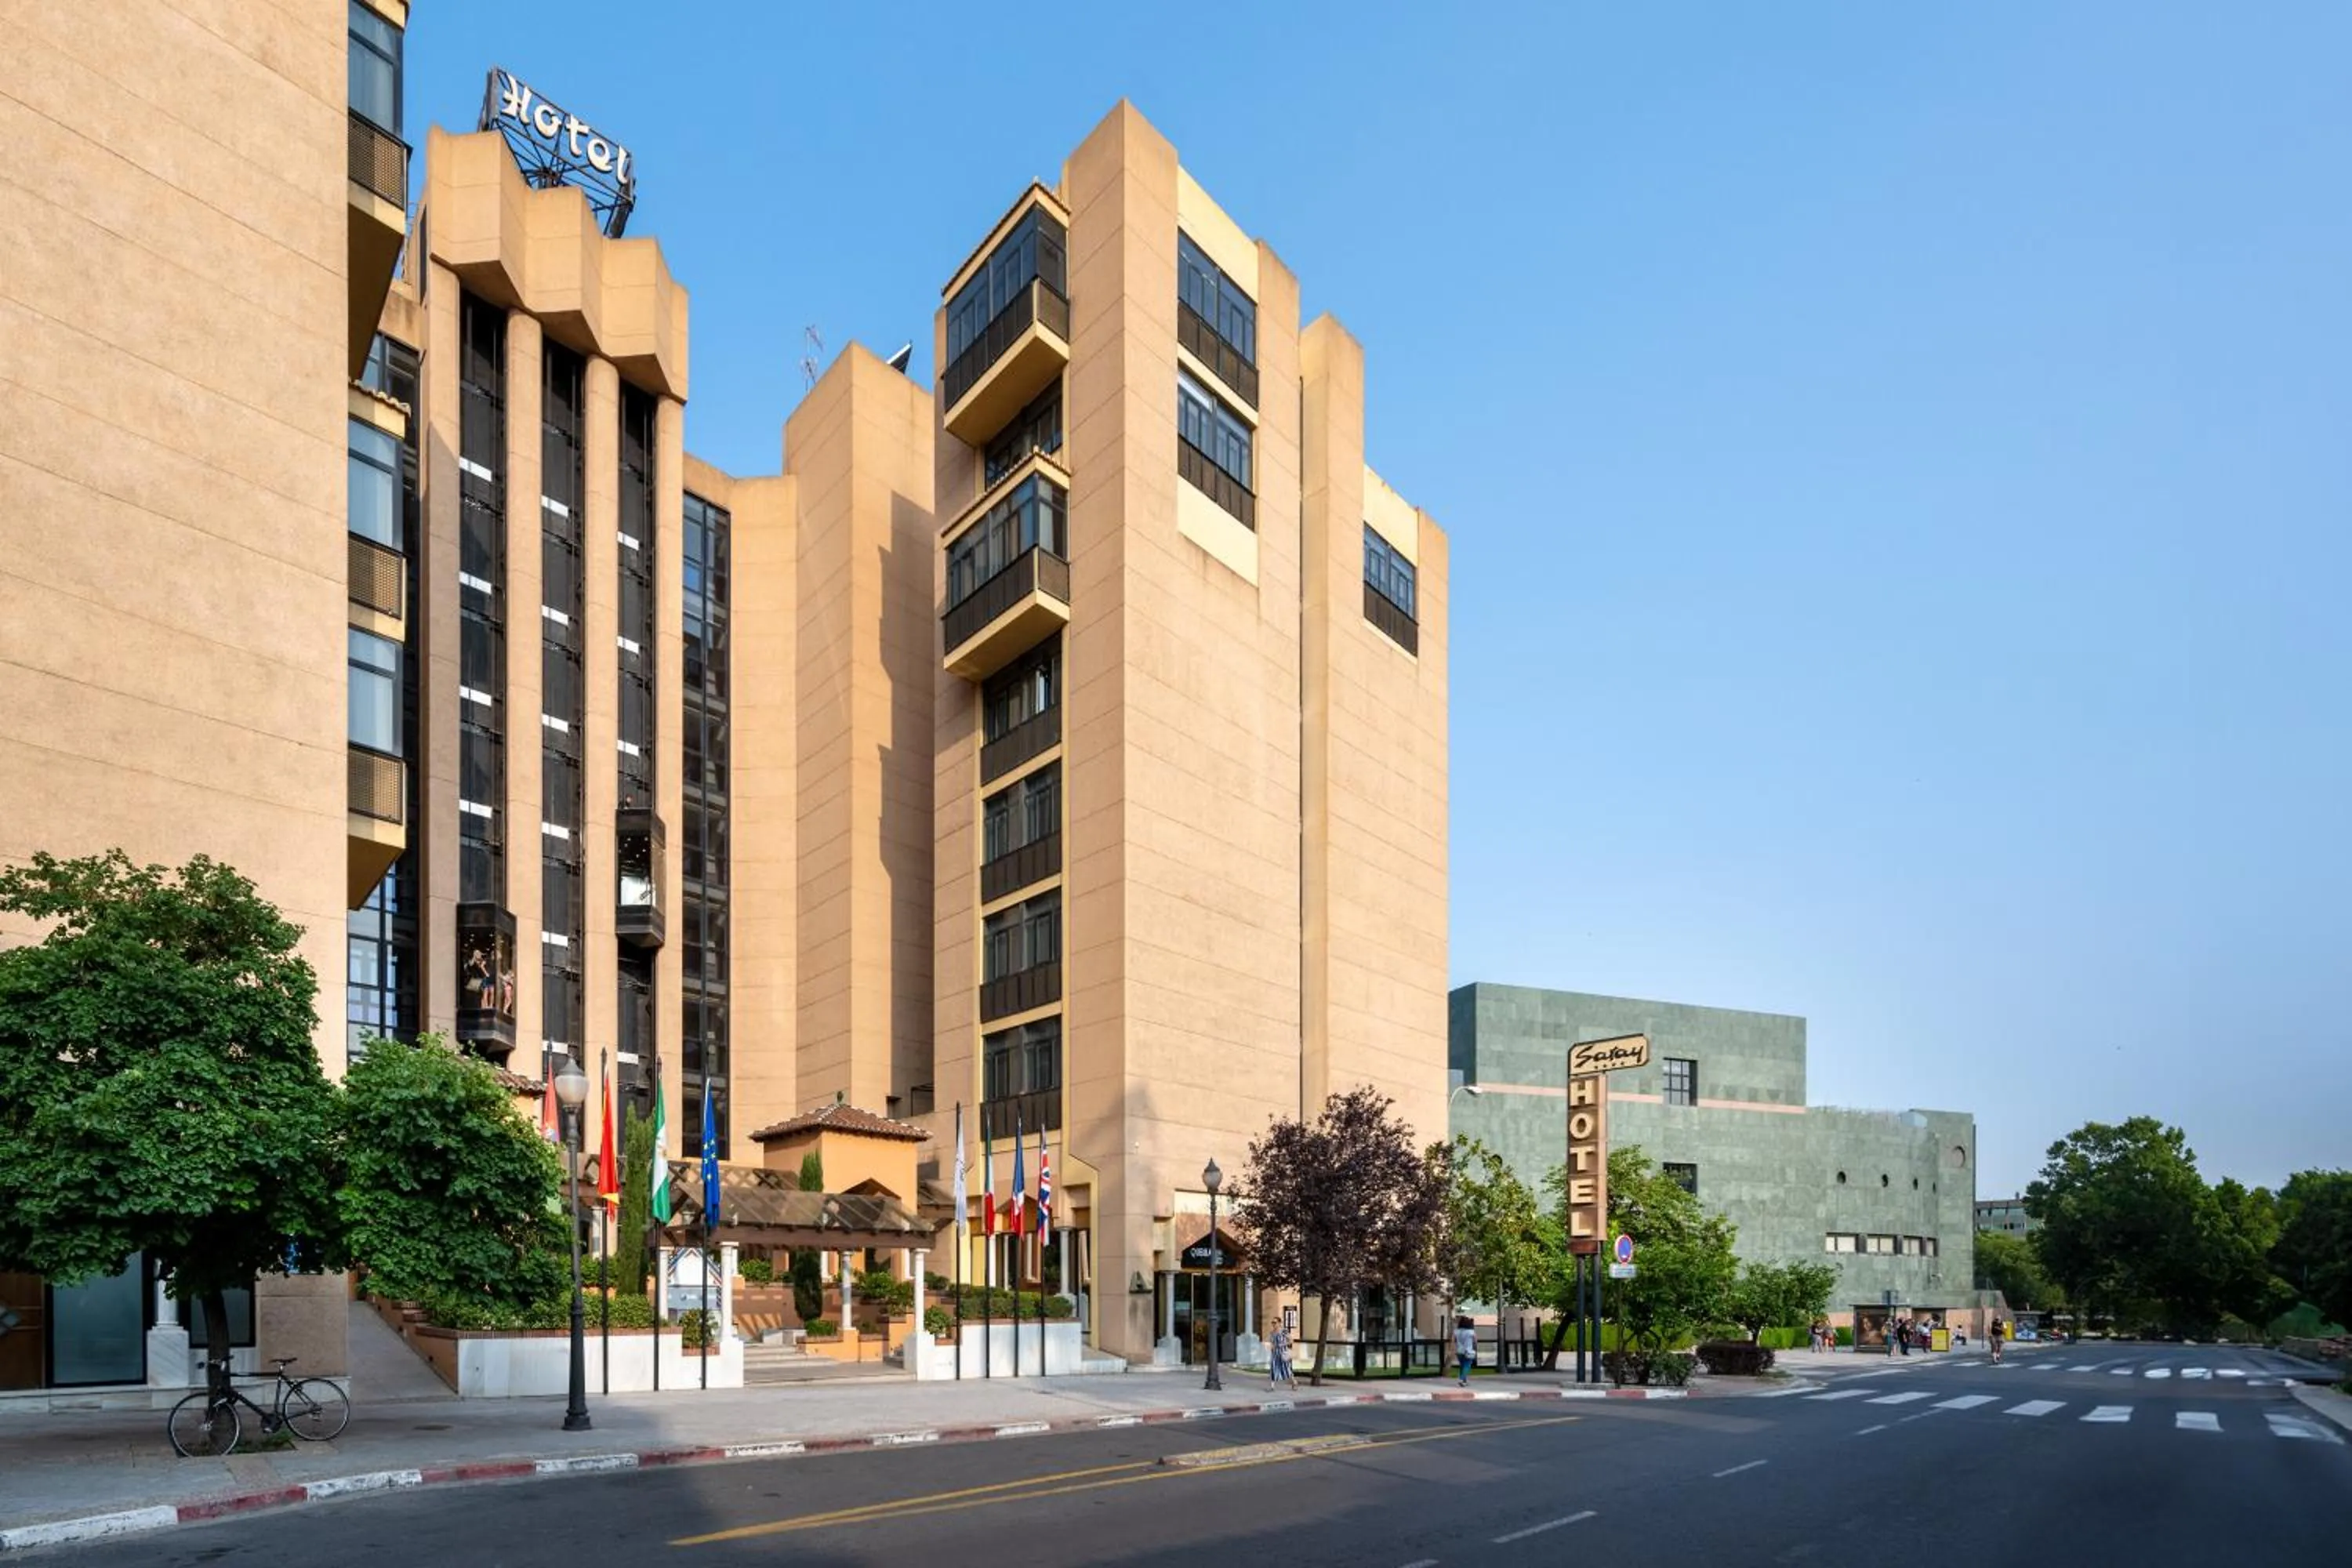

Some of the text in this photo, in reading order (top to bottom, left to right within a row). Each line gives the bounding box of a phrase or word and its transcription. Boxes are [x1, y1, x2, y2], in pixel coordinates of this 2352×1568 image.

[500, 74, 628, 184] Hotel
[1574, 1045, 1644, 1068] Saray
[1570, 1079, 1595, 1237] HOTEL
